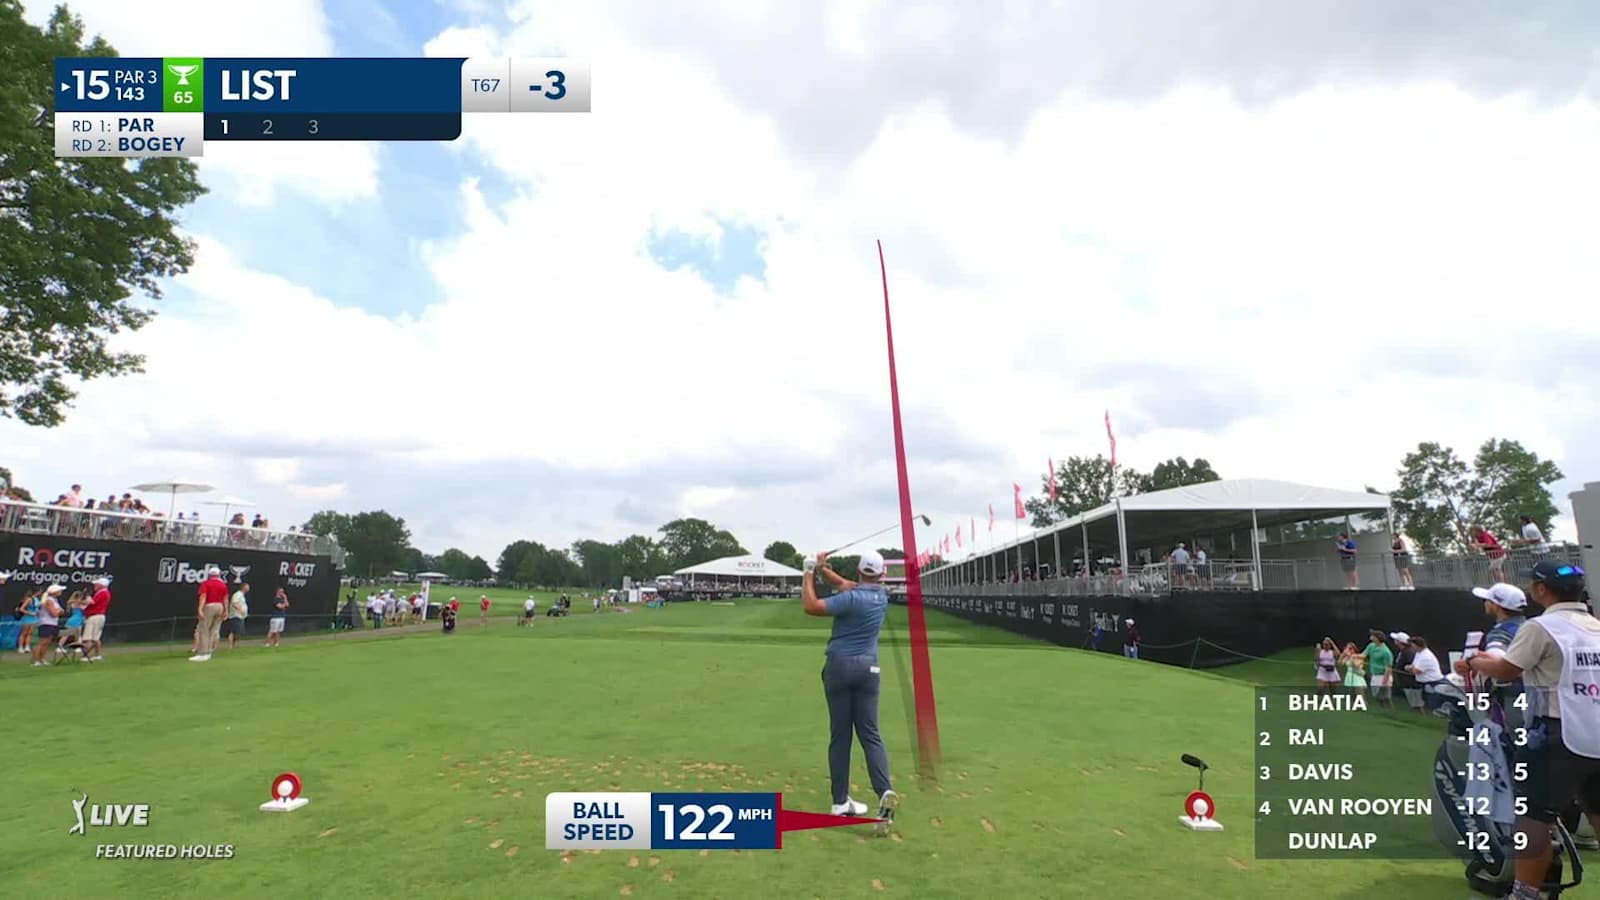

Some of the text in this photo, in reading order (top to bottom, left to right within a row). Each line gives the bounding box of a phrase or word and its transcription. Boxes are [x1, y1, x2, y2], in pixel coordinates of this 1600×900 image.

[18, 547, 111, 569] ROCKET
[5, 569, 69, 585] Mortgage
[1576, 652, 1600, 667] HISA
